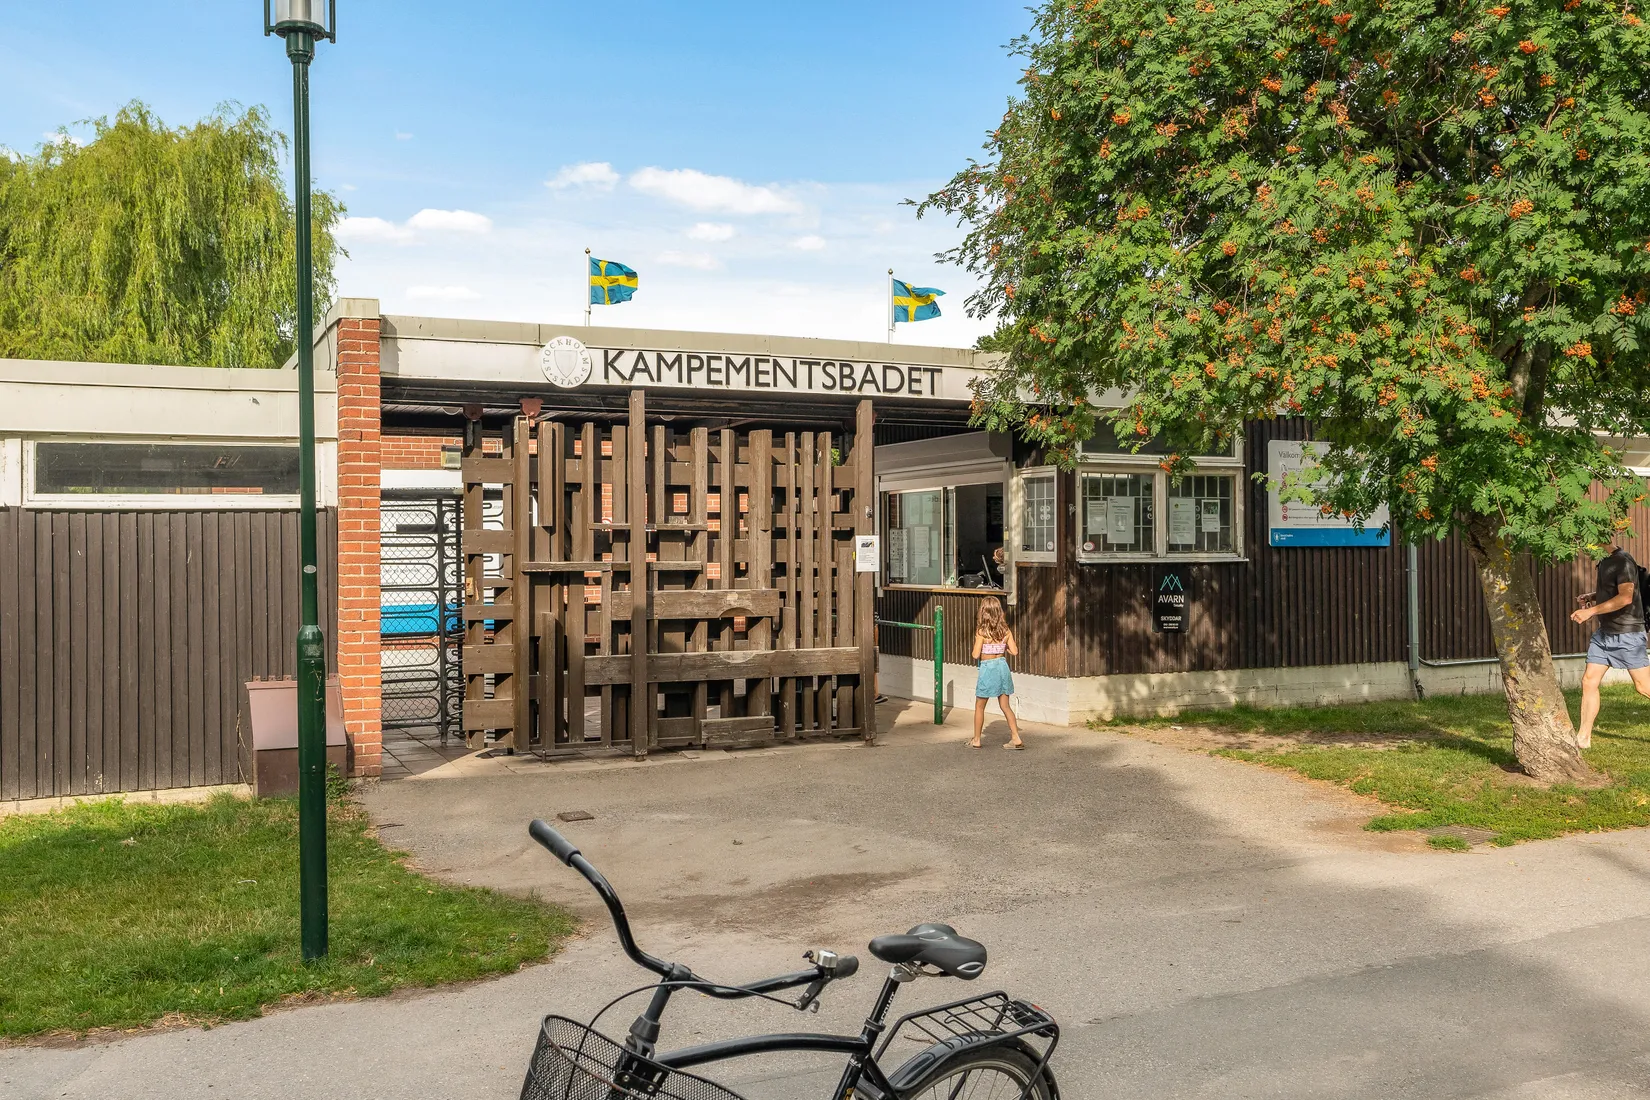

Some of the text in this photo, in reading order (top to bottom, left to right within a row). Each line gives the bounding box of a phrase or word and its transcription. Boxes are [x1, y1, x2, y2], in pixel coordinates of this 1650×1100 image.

[543, 339, 589, 372] STOCKHOLMS
[552, 375, 581, 386] STAD
[603, 349, 943, 396] KAMPEMENTSBADET
[1158, 594, 1185, 603] AVARN
